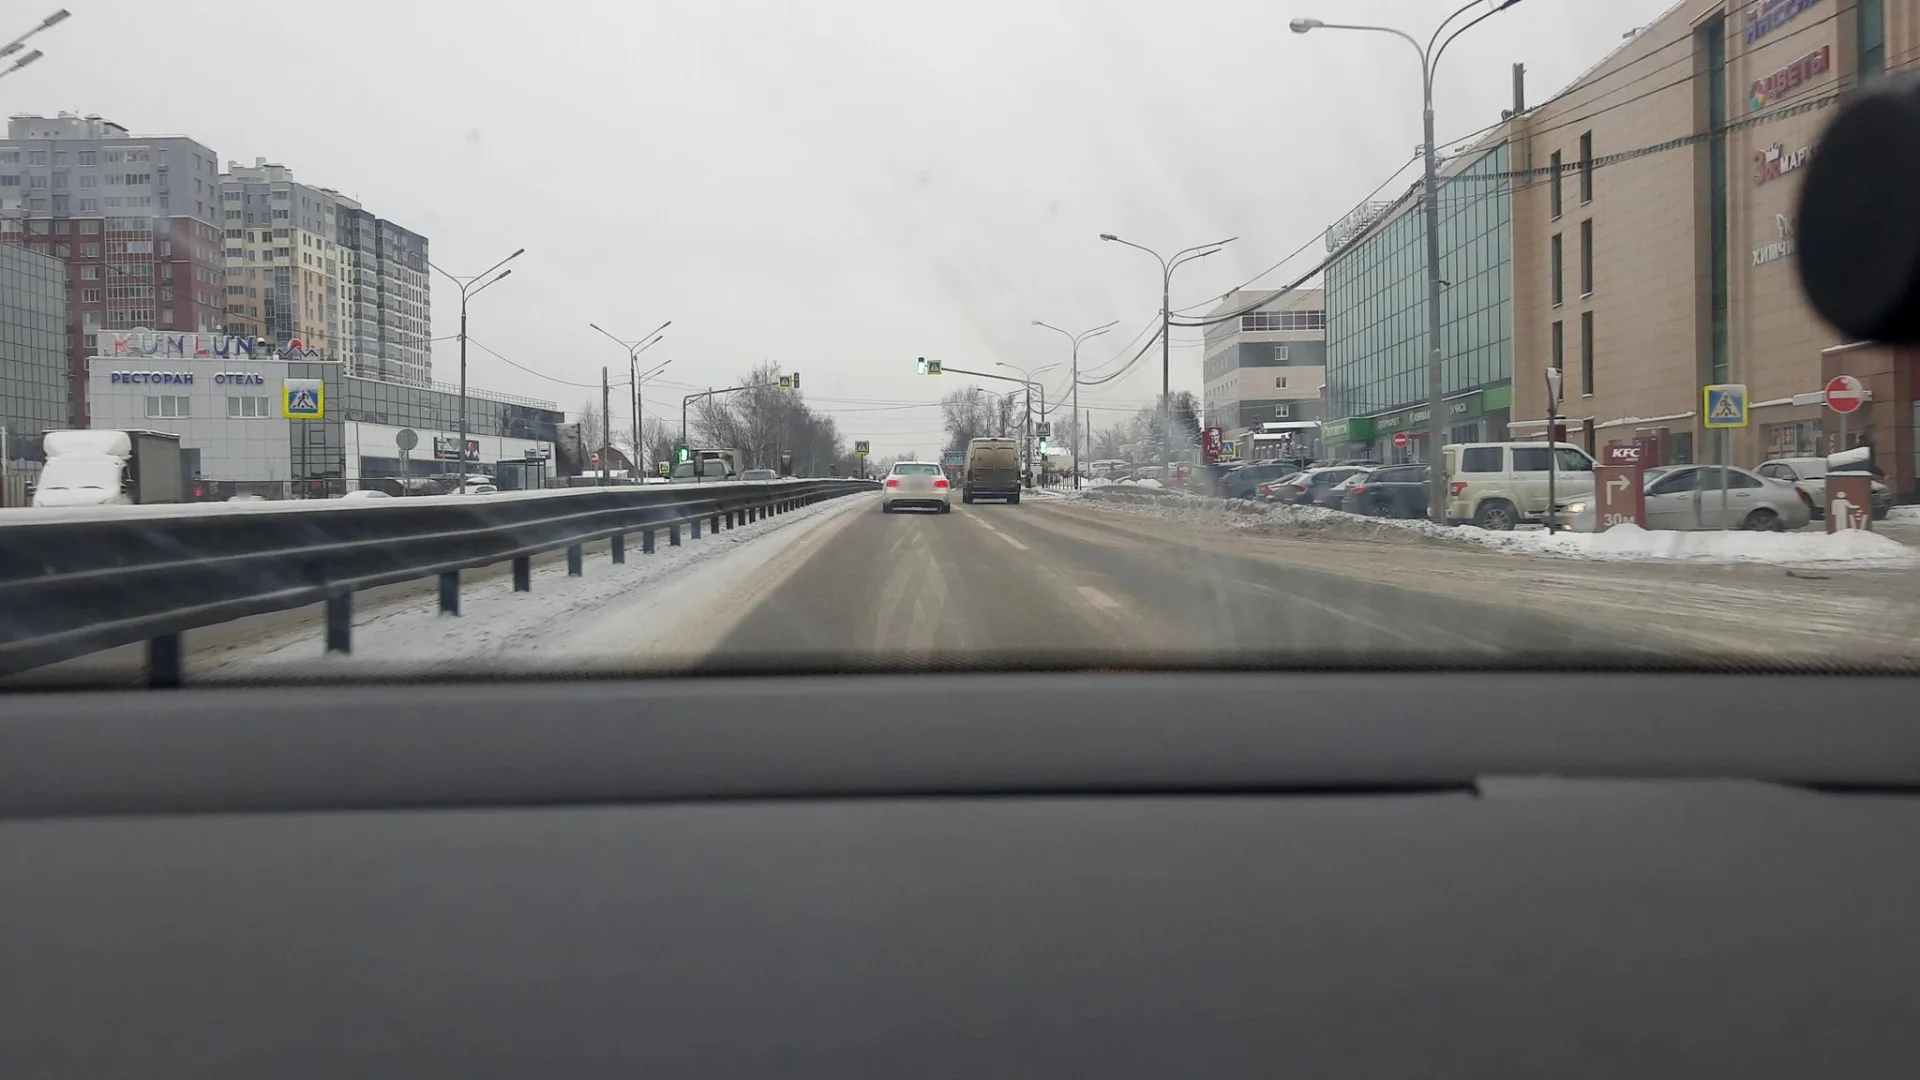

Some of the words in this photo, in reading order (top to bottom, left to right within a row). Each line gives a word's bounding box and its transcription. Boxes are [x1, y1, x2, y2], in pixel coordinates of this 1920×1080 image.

[111, 371, 194, 385] РЕСТОРАН
[214, 372, 264, 385] ОТЕЛЬ
[1612, 448, 1640, 458] KFC
